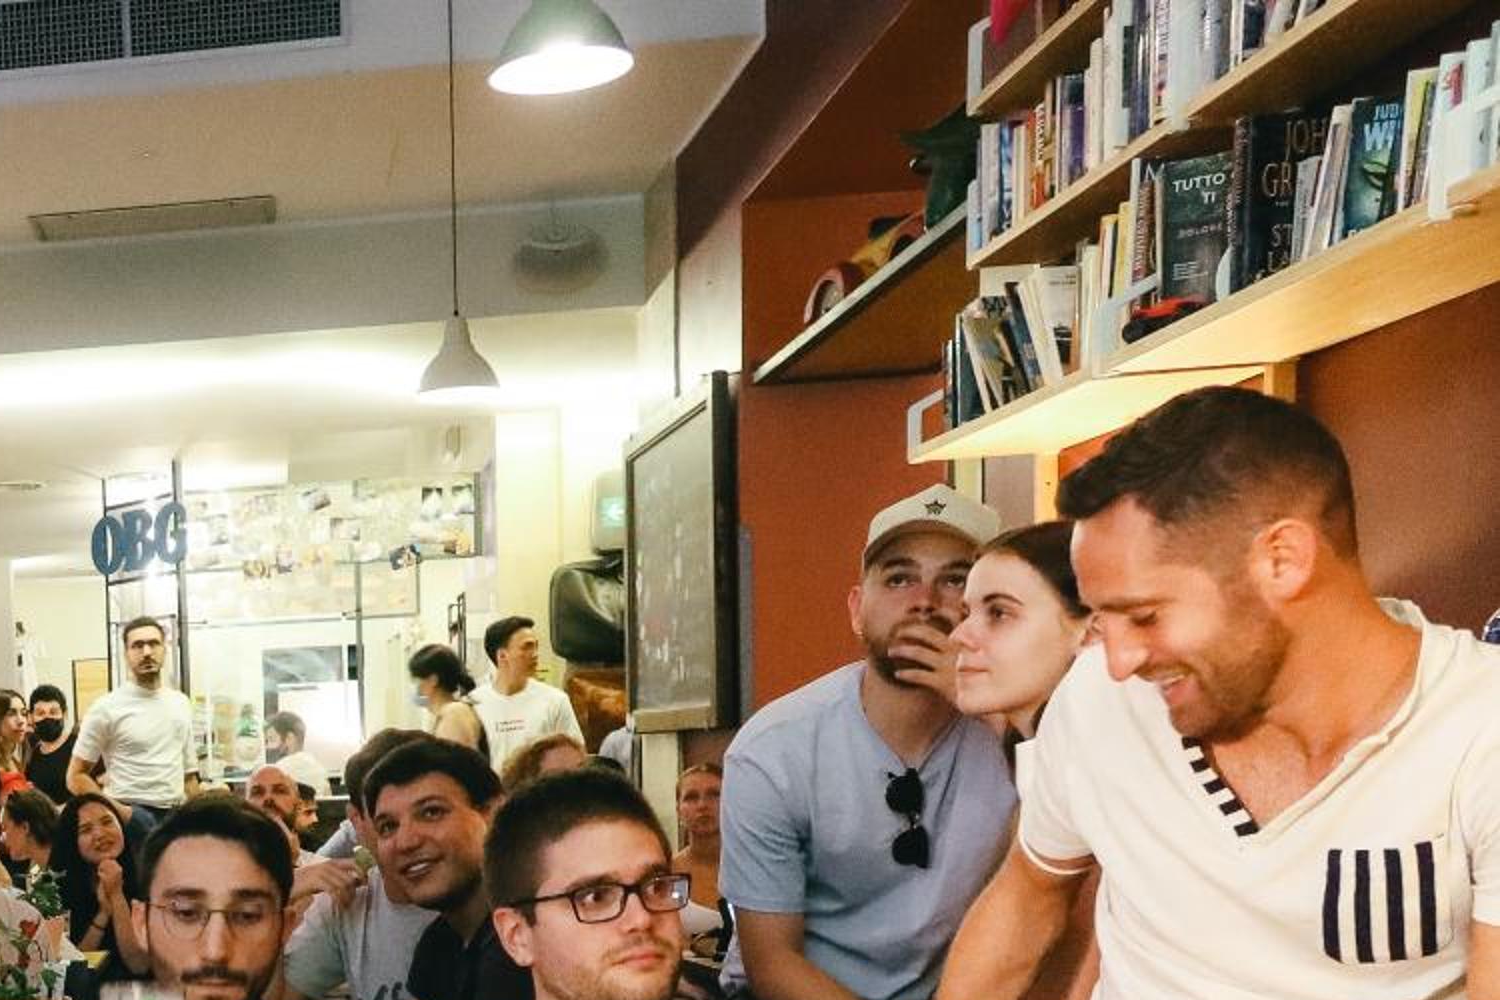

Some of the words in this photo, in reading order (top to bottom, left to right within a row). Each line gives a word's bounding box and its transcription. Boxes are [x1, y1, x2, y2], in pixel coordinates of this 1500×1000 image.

[1172, 173, 1225, 192] TUTTO
[1202, 191, 1217, 204] TI
[92, 502, 187, 576] OBG
